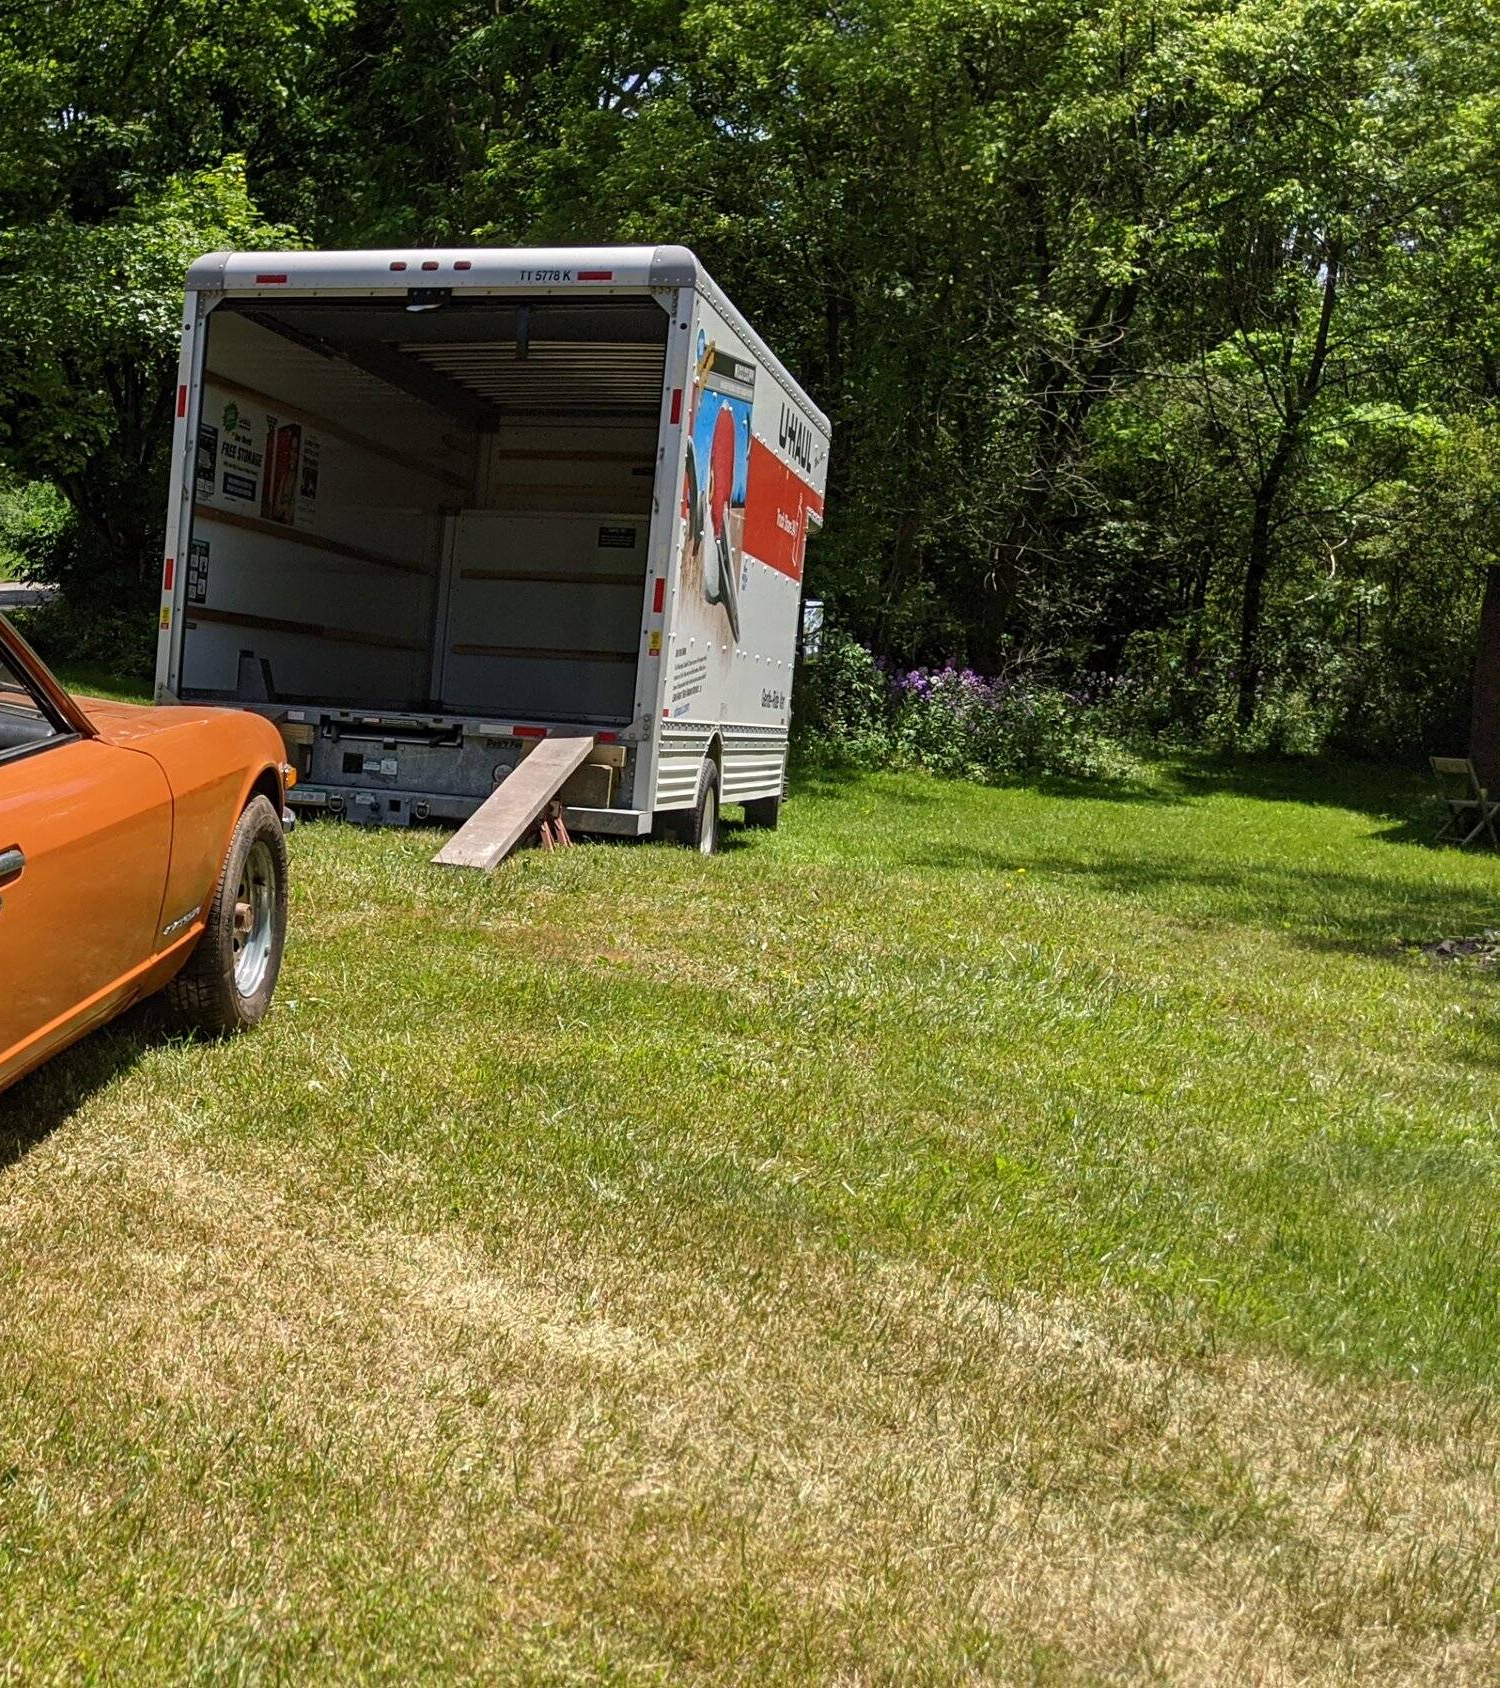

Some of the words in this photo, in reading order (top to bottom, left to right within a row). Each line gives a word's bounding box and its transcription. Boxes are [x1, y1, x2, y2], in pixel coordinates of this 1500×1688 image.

[520, 270, 531, 281] TT
[535, 270, 560, 281] 5778
[563, 270, 571, 281] K
[779, 402, 812, 474] U-HAUL
[221, 442, 237, 459] FREE
